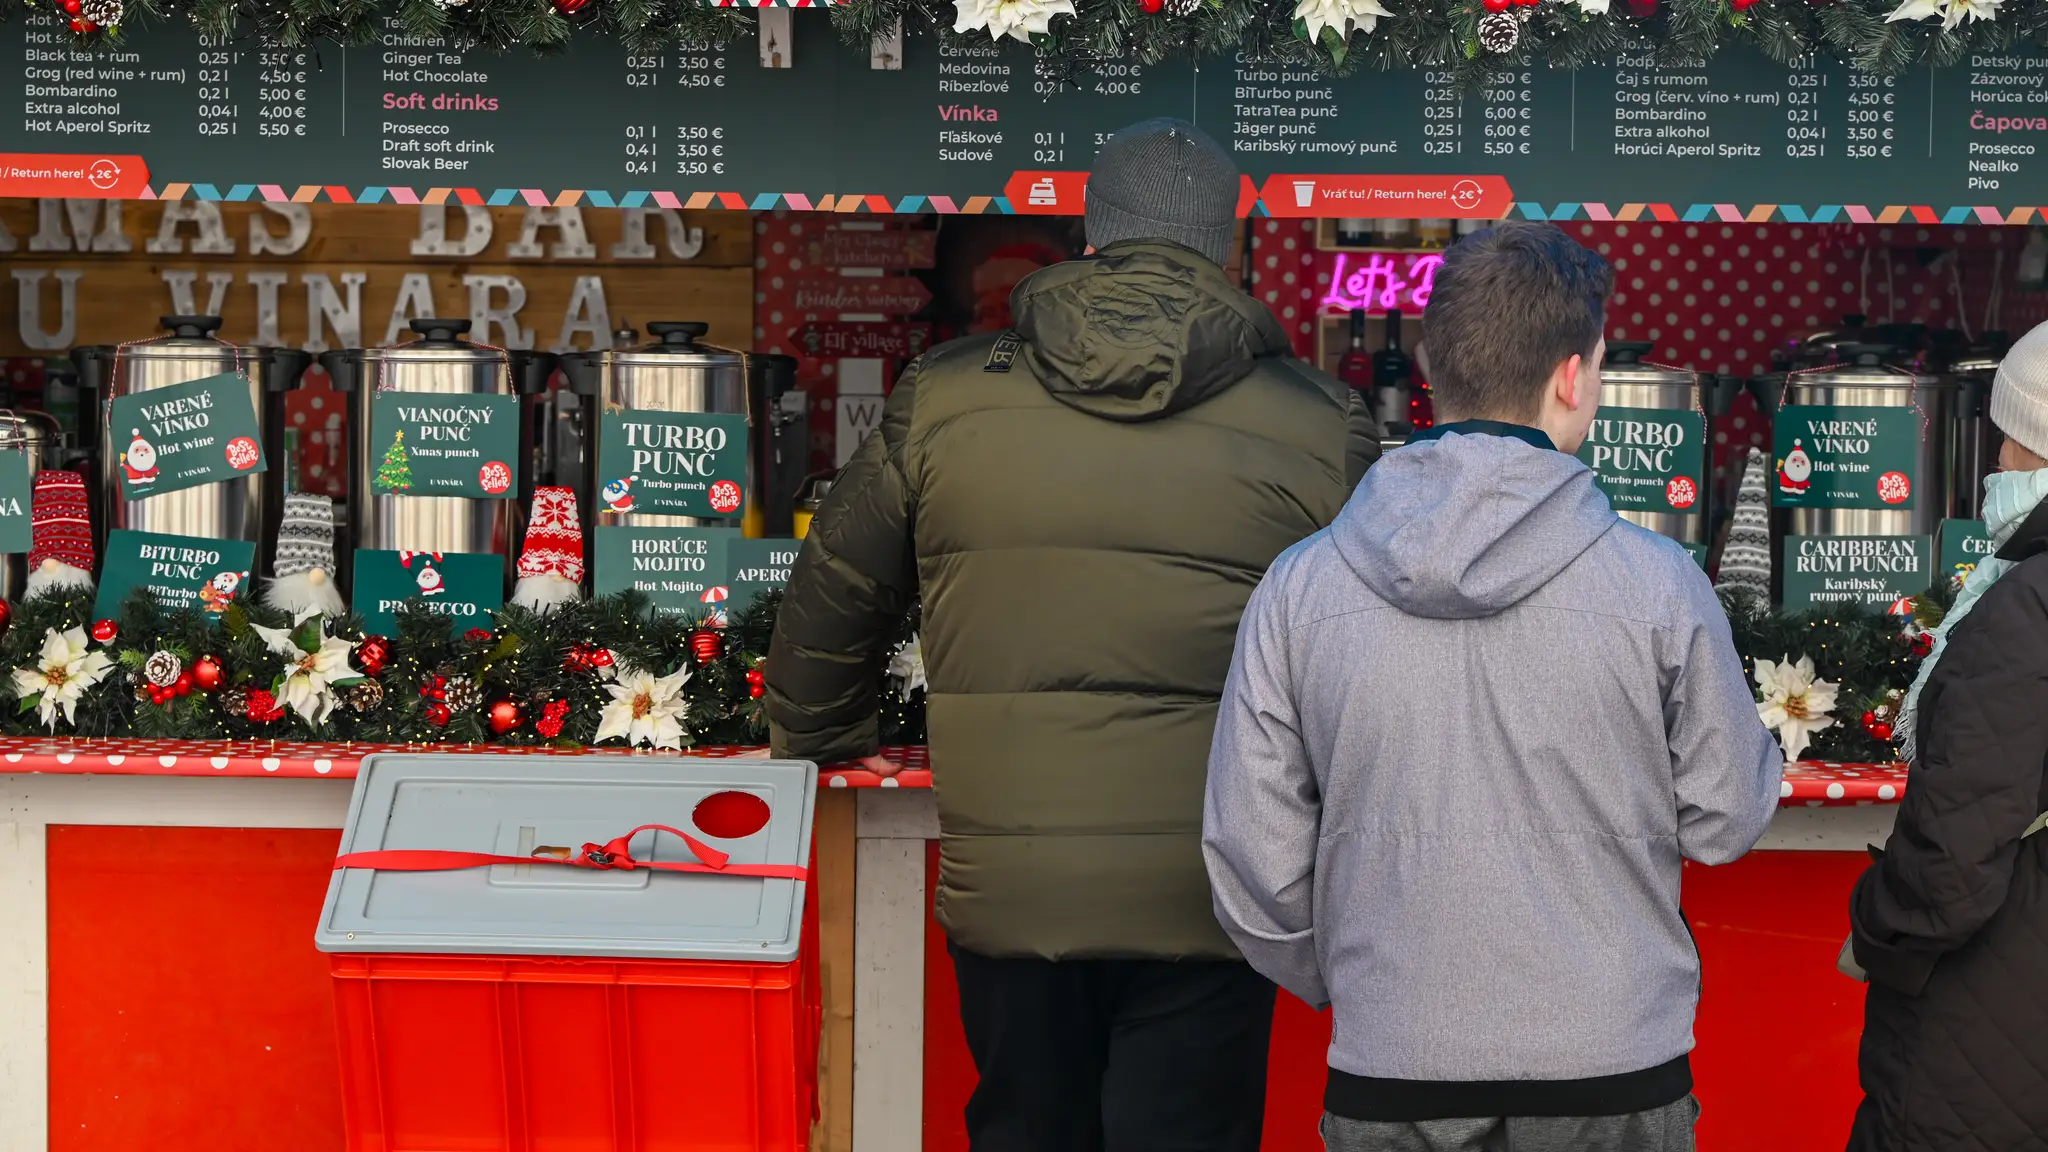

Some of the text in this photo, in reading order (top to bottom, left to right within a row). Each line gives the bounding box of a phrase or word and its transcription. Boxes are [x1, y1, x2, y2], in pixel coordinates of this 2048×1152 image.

[26, 32, 51, 43] Hot
[26, 49, 66, 61] Black
[70, 51, 92, 61] tea
[110, 53, 139, 62] rum
[383, 52, 461, 66] Ginger Tea
[940, 63, 1010, 74] Medovina
[1972, 56, 2021, 70] Detský
[26, 67, 60, 81] Grog
[66, 67, 93, 81] (red
[98, 68, 134, 80] wine
[151, 69, 185, 83] rum)
[384, 70, 487, 82] Hot Chocolate
[1235, 69, 1319, 84] Turbo punč
[1616, 71, 1707, 87] Čaj s rumom
[1971, 73, 2044, 87] Zázvorový
[26, 85, 117, 97] Bombardino
[1095, 83, 1140, 95] 4,00 €
[1236, 87, 1332, 101] BiTurbo punč
[384, 93, 498, 110] Soft drinks
[1616, 91, 1650, 105] Grog
[1656, 91, 1693, 105] (červ.
[1698, 91, 1729, 102] víno
[1745, 92, 1779, 106] rum)
[1971, 91, 2022, 102] Horúca
[26, 102, 119, 114] Extra alcohol
[939, 105, 997, 121] Vínka
[1234, 105, 1337, 119] TatraTea punč
[1616, 108, 1706, 120] Bombardino
[26, 120, 150, 135] Hot Aperol Spritz
[199, 123, 228, 136] 0,25
[260, 124, 289, 137] 5,50
[295, 124, 305, 135] €
[383, 122, 449, 134] Prosecco
[1234, 122, 1316, 136] Jäger punč
[1616, 126, 1709, 137] Extra alkohol
[383, 140, 494, 152] Draft soft drink
[1235, 139, 1397, 155] Karibský rumový punč
[1424, 142, 1453, 155] 0,25
[1484, 143, 1513, 155] 5,50
[1519, 143, 1530, 154] €
[1615, 143, 1760, 158] Horúci Aperol Spritz
[1787, 145, 1816, 158] 0,25
[1847, 146, 1876, 158] 5,50
[1881, 146, 1891, 157] €
[1970, 143, 2035, 154] Prosecco
[939, 149, 992, 160] Sudové
[383, 157, 468, 169] Slovak Beer
[626, 161, 648, 174] 0,4
[678, 162, 707, 175] 3,50
[713, 163, 723, 174] €
[1969, 160, 2018, 172] Nealko
[11, 168, 84, 179] Return here!
[97, 170, 111, 179] 2€
[1969, 177, 1999, 189] Pivo
[1349, 188, 1364, 199] tu!
[1375, 189, 1413, 199] Return
[1416, 189, 1446, 200] here!
[1459, 190, 1474, 200] 2€
[0, 199, 312, 256] MAS
[1321, 254, 1406, 308] Let's
[11, 269, 84, 350] U
[824, 332, 848, 349] Elf
[140, 390, 213, 421] VARENÉ
[397, 405, 493, 425] VIANOČNÝ
[151, 412, 209, 437] VÍNKO
[1807, 418, 1877, 437] VARENÉ
[420, 423, 471, 442] PUNČ
[622, 422, 726, 451] TURBO
[1587, 419, 1684, 447] TURBO
[158, 435, 215, 456] Hot wine
[1814, 436, 1870, 454] VÍNKO
[411, 446, 479, 459] Xmas punch
[1592, 442, 1673, 473] PUNČ
[632, 448, 715, 476] PUNČ
[1814, 461, 1870, 473] Hot wine
[642, 479, 705, 492] Turbo punch
[1601, 475, 1664, 487] Turbo punch
[631, 536, 707, 554] HORÚCE
[1799, 540, 1915, 557] CARIBBEAN
[139, 544, 220, 565] BiTURBO
[769, 551, 799, 565] HO
[151, 562, 202, 580] PUNČ
[632, 556, 705, 572] MOJITO
[1796, 556, 1918, 573] RUM PUNCH
[634, 580, 704, 594] Hot Mojito
[1825, 578, 1887, 592] Karibský
[1810, 589, 1863, 604] rumový
[379, 600, 476, 616] PRECCO
